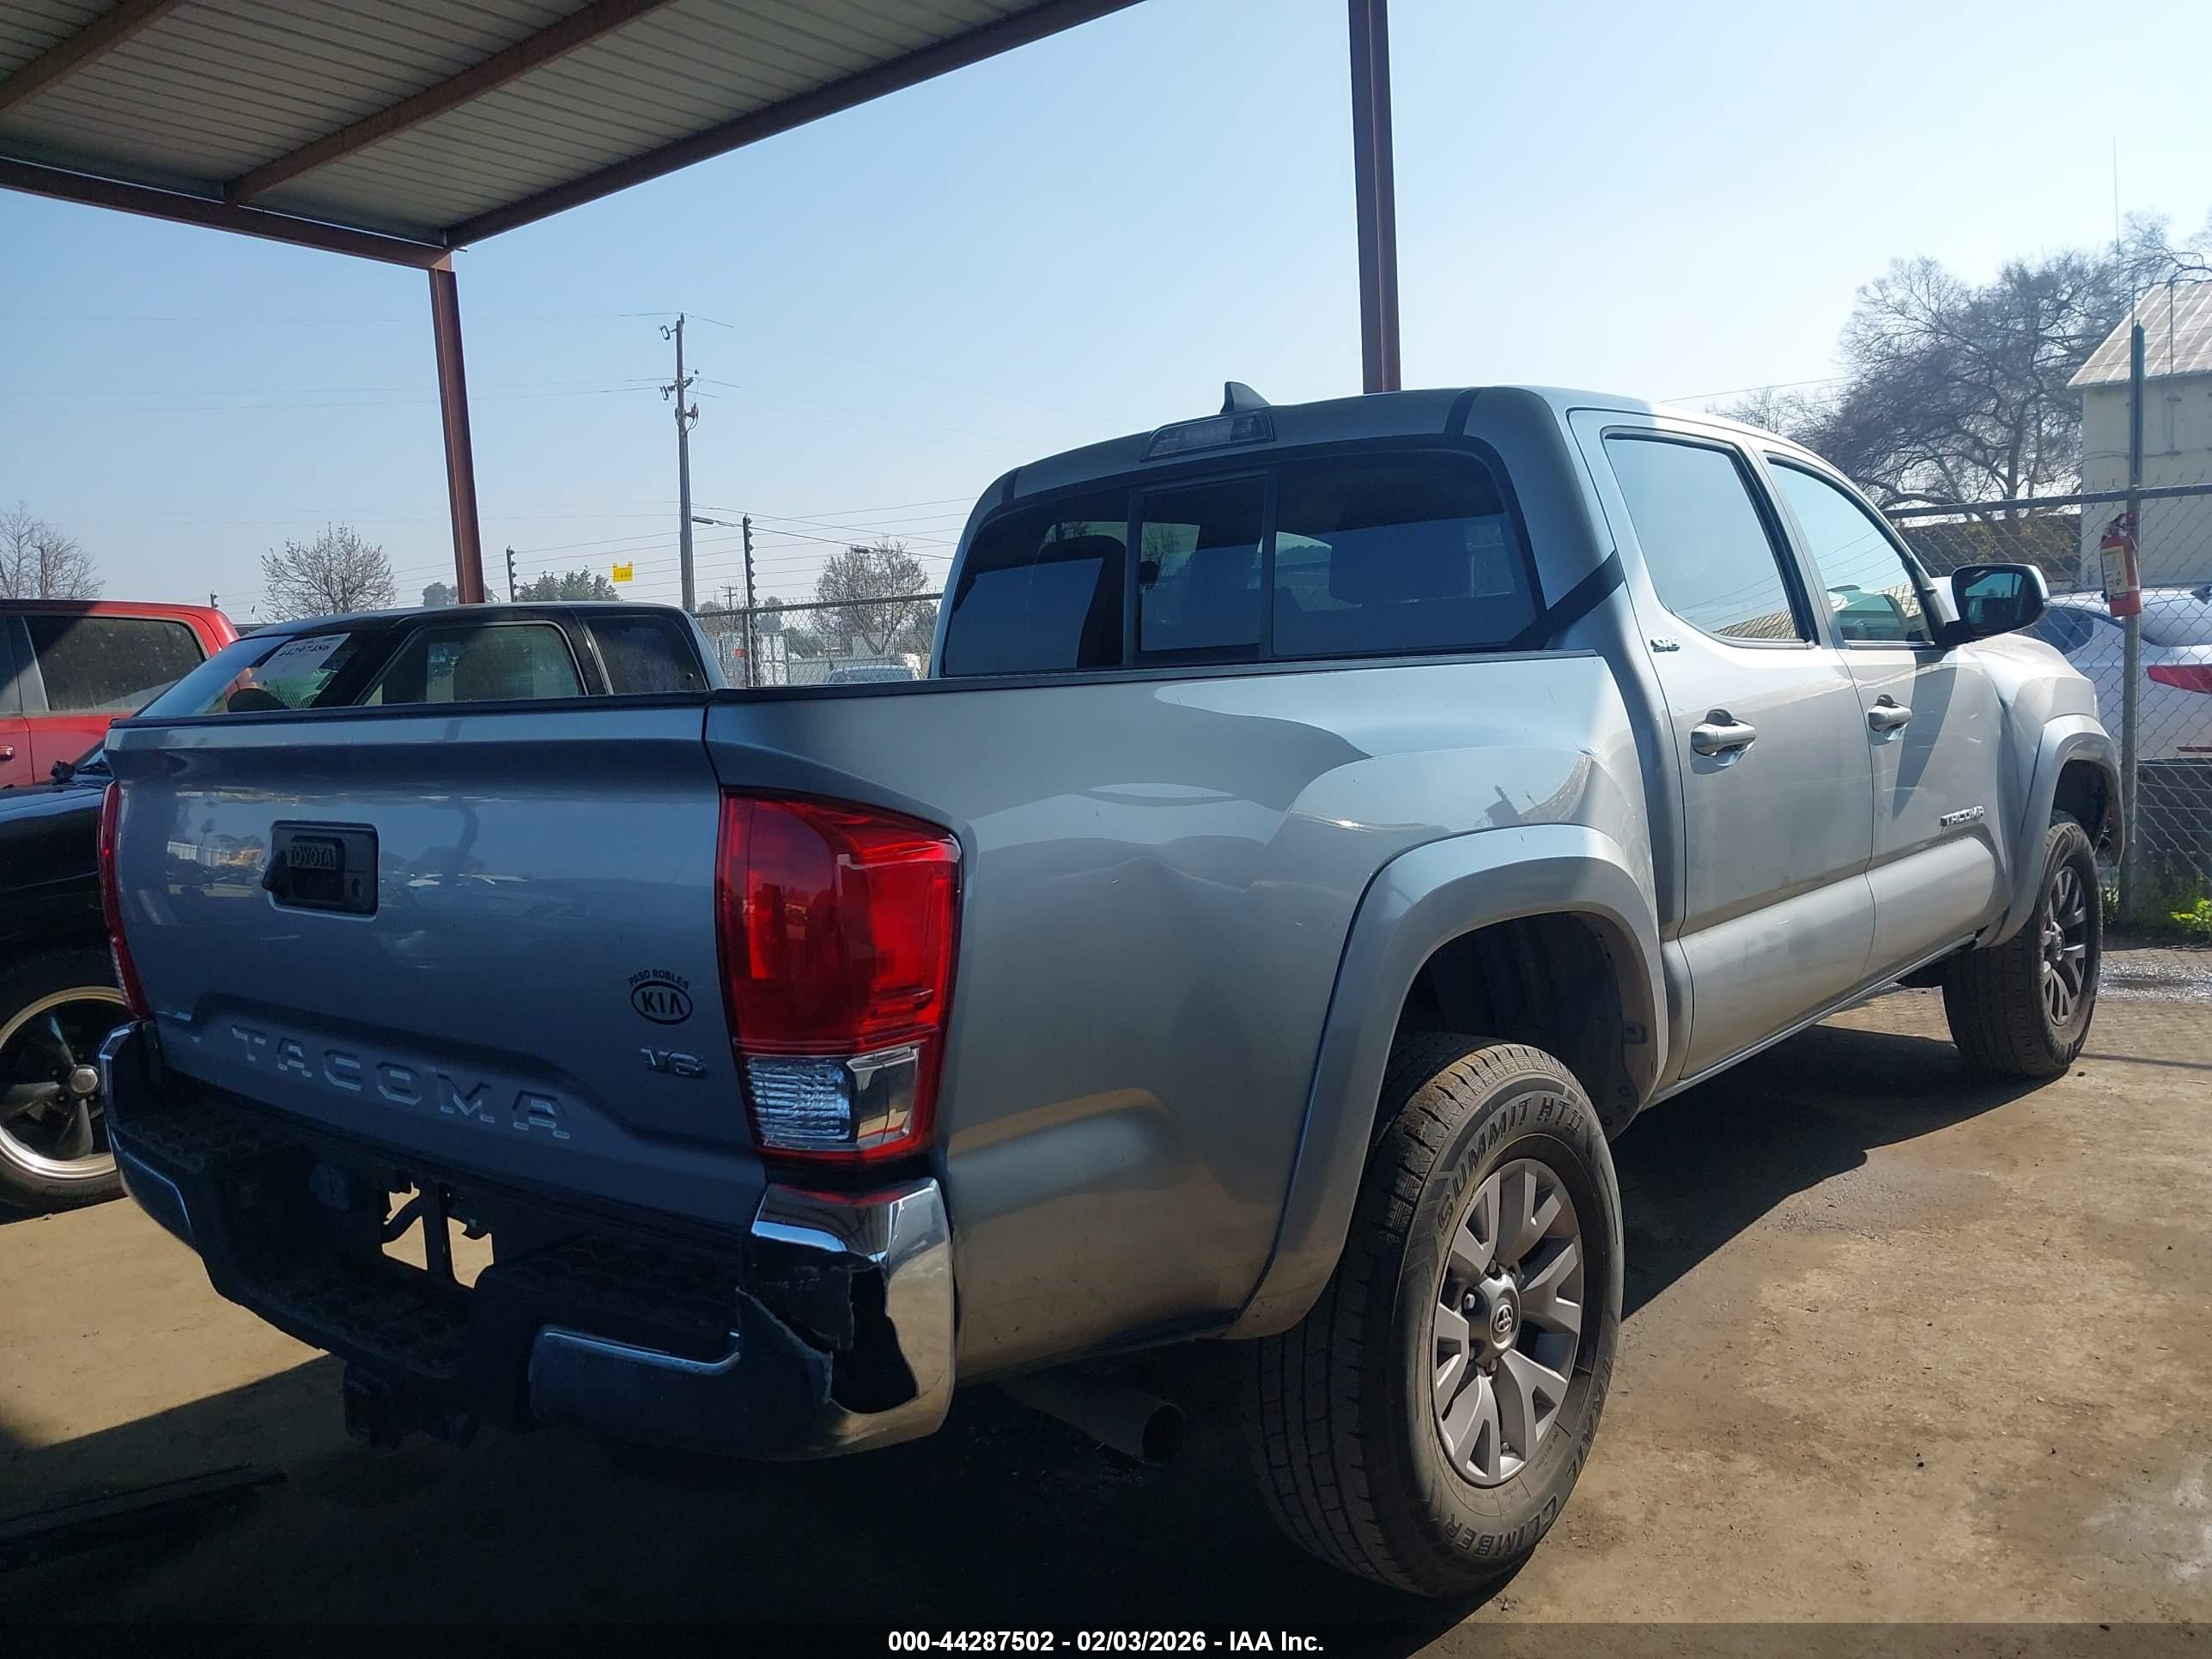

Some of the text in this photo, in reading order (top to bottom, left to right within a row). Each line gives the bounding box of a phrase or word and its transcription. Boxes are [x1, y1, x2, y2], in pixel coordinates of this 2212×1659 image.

[1940, 805, 1984, 826] TACOMA
[288, 845, 333, 867] TOYOTA
[629, 969, 690, 990] PASO ROBLES
[641, 991, 685, 1015] KIA
[640, 1046, 707, 1079] V6
[232, 1025, 570, 1140] TACOMA
[1437, 1097, 1533, 1237] SUMMIT
[1443, 1493, 1559, 1559] CLIMBER
